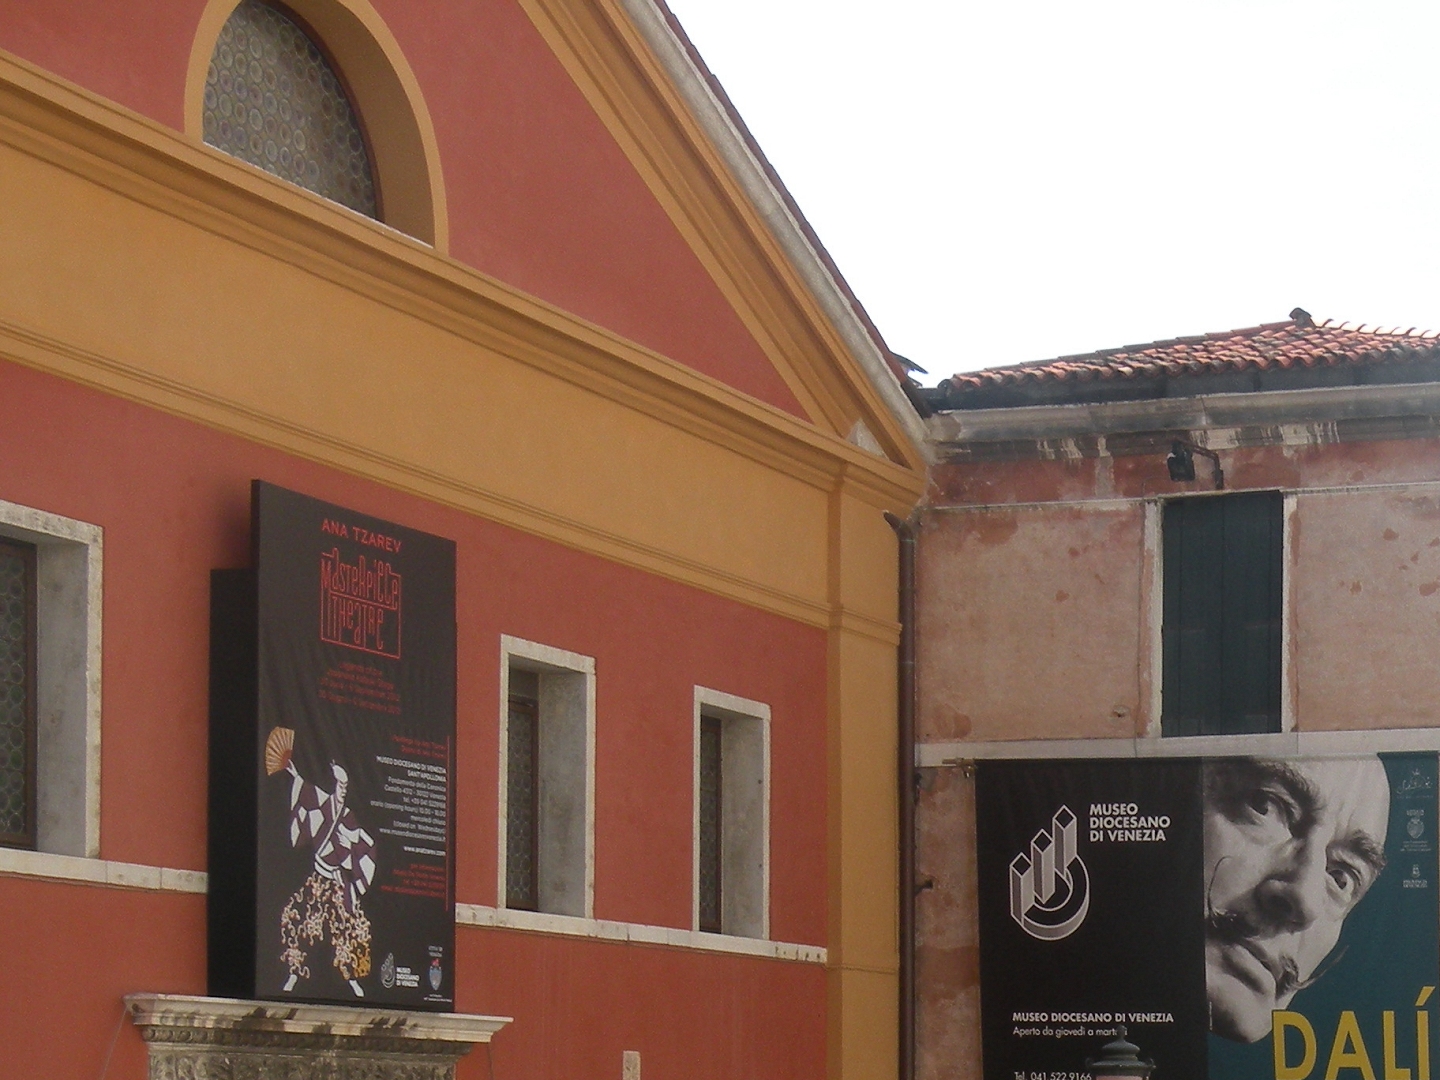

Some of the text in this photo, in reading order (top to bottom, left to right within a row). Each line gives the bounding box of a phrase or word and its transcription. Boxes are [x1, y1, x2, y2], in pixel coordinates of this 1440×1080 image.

[321, 518, 402, 553] ANA TZAREV
[1089, 803, 1139, 816] MUSEO
[1089, 816, 1171, 829] DIOCESANO
[1089, 829, 1167, 842] DI VENEZIA
[1012, 1012, 1174, 1023] MUSEO DIOCESANO DI VENEZIA
[1012, 1026, 1041, 1038] Aperto
[1042, 1026, 1054, 1036] da
[1014, 1071, 1027, 1080] Tel.
